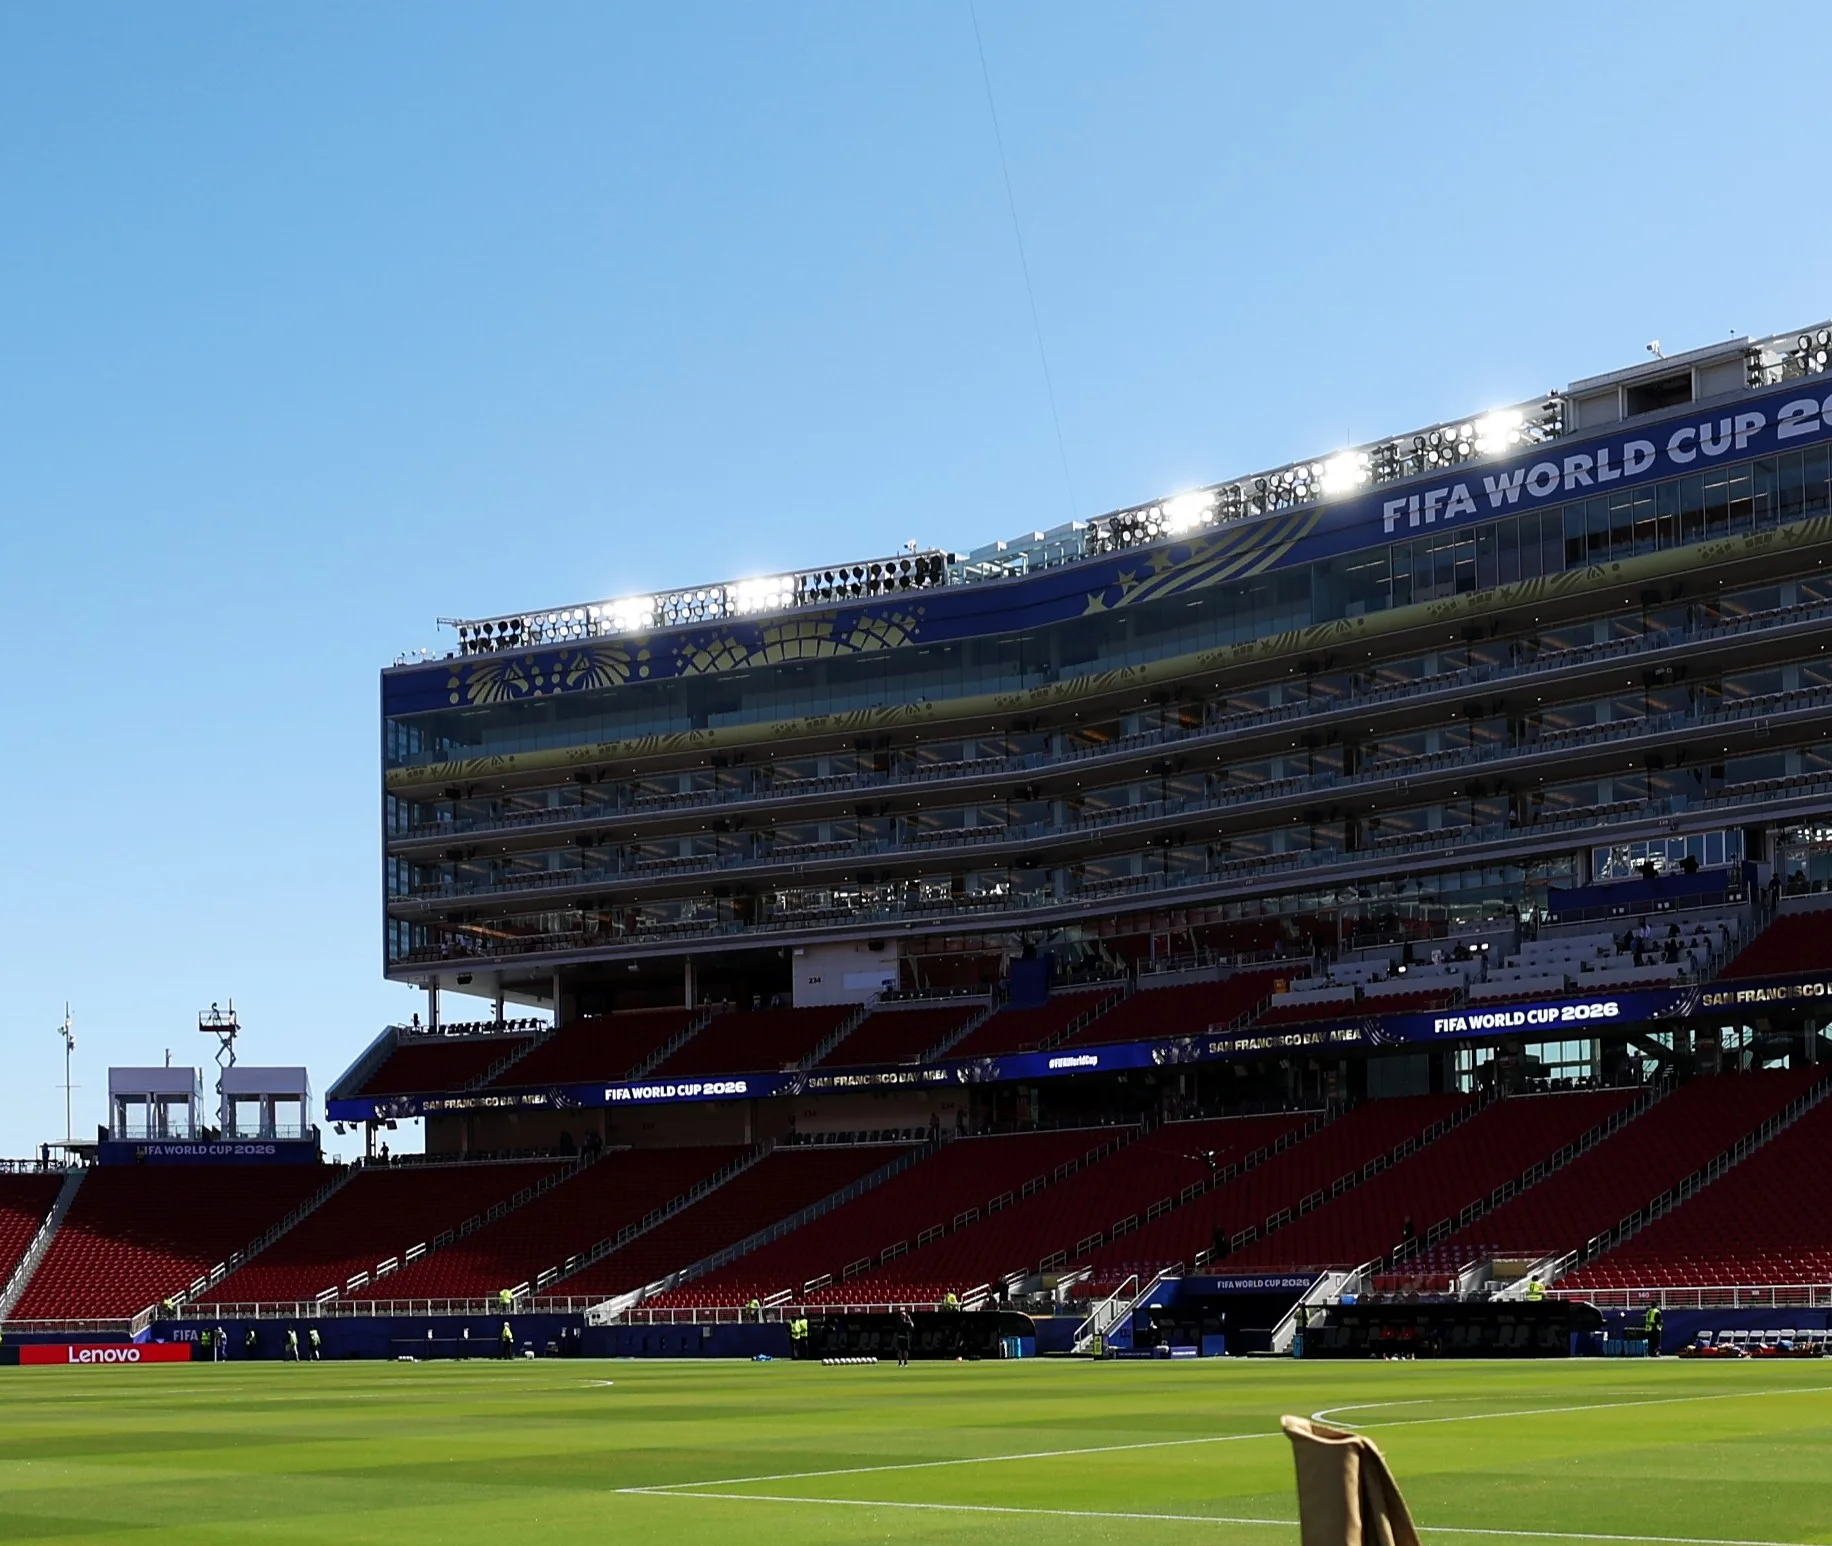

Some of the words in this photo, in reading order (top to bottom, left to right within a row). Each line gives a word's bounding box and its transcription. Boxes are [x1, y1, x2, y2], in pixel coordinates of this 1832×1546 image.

[1383, 483, 1477, 533] FIFA
[1482, 439, 1658, 507] WORLD
[1667, 411, 1767, 463] CUP
[1702, 992, 1735, 1007] SAN
[1737, 983, 1824, 1003] FRANCISCO
[1435, 1016, 1467, 1033] FIFA
[1468, 1012, 1525, 1030] WORLD
[1527, 1008, 1559, 1024] CUP
[1561, 1002, 1619, 1021] 2026
[1209, 1041, 1234, 1053] SAN
[1235, 1034, 1301, 1051] FRANCISCO
[1303, 1032, 1327, 1044] BAY
[1329, 1028, 1362, 1041] AREA
[808, 1077, 832, 1088] SAN
[833, 1073, 898, 1087] FRANCISCO
[899, 1071, 920, 1083] BAY
[923, 1069, 948, 1080] AREA
[605, 1088, 630, 1100] FIFA
[632, 1085, 675, 1098] WORLD
[677, 1084, 701, 1096] CUP
[703, 1081, 747, 1095] 2026
[423, 1100, 443, 1110] SAN
[444, 1097, 499, 1109] FRANCISCO
[500, 1095, 519, 1106] BAY
[521, 1094, 548, 1104] AREA
[138, 1145, 163, 1155] IFA
[164, 1145, 207, 1155] WORLD
[209, 1145, 232, 1155] CUP
[234, 1145, 276, 1155] 2026
[1218, 1281, 1233, 1289] FIFA
[1234, 1280, 1263, 1288] WORLD
[1265, 1280, 1280, 1288] CUP
[1282, 1278, 1310, 1287] 2026
[173, 1330, 198, 1341] FIFA
[69, 1346, 140, 1363] Lenovo
